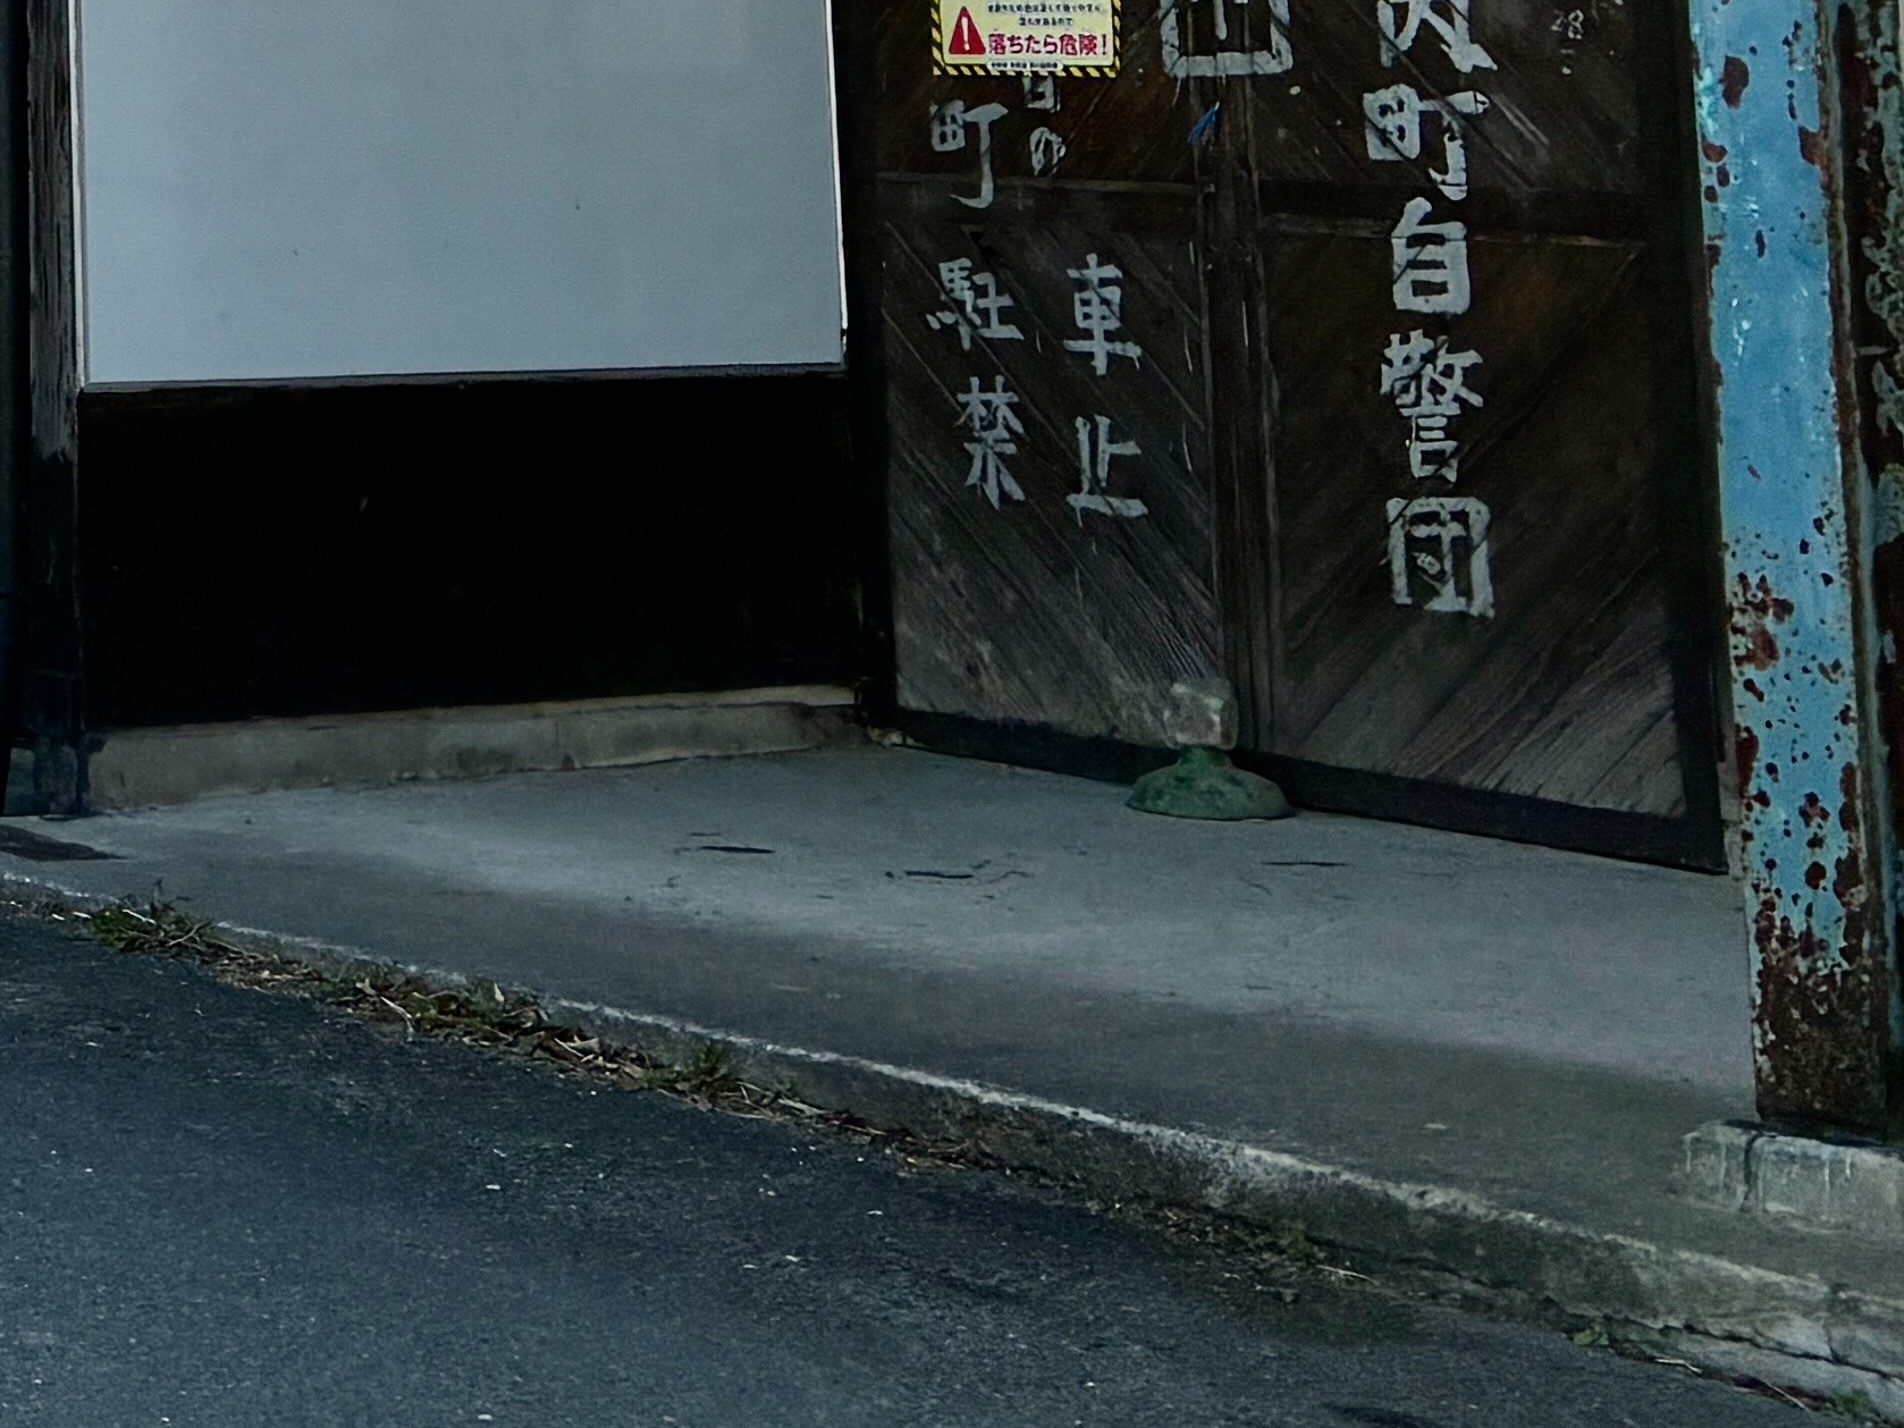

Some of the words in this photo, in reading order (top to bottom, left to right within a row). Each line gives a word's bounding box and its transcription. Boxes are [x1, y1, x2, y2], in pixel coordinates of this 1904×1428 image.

[989, 33, 1108, 56] 落ちたら危険！
